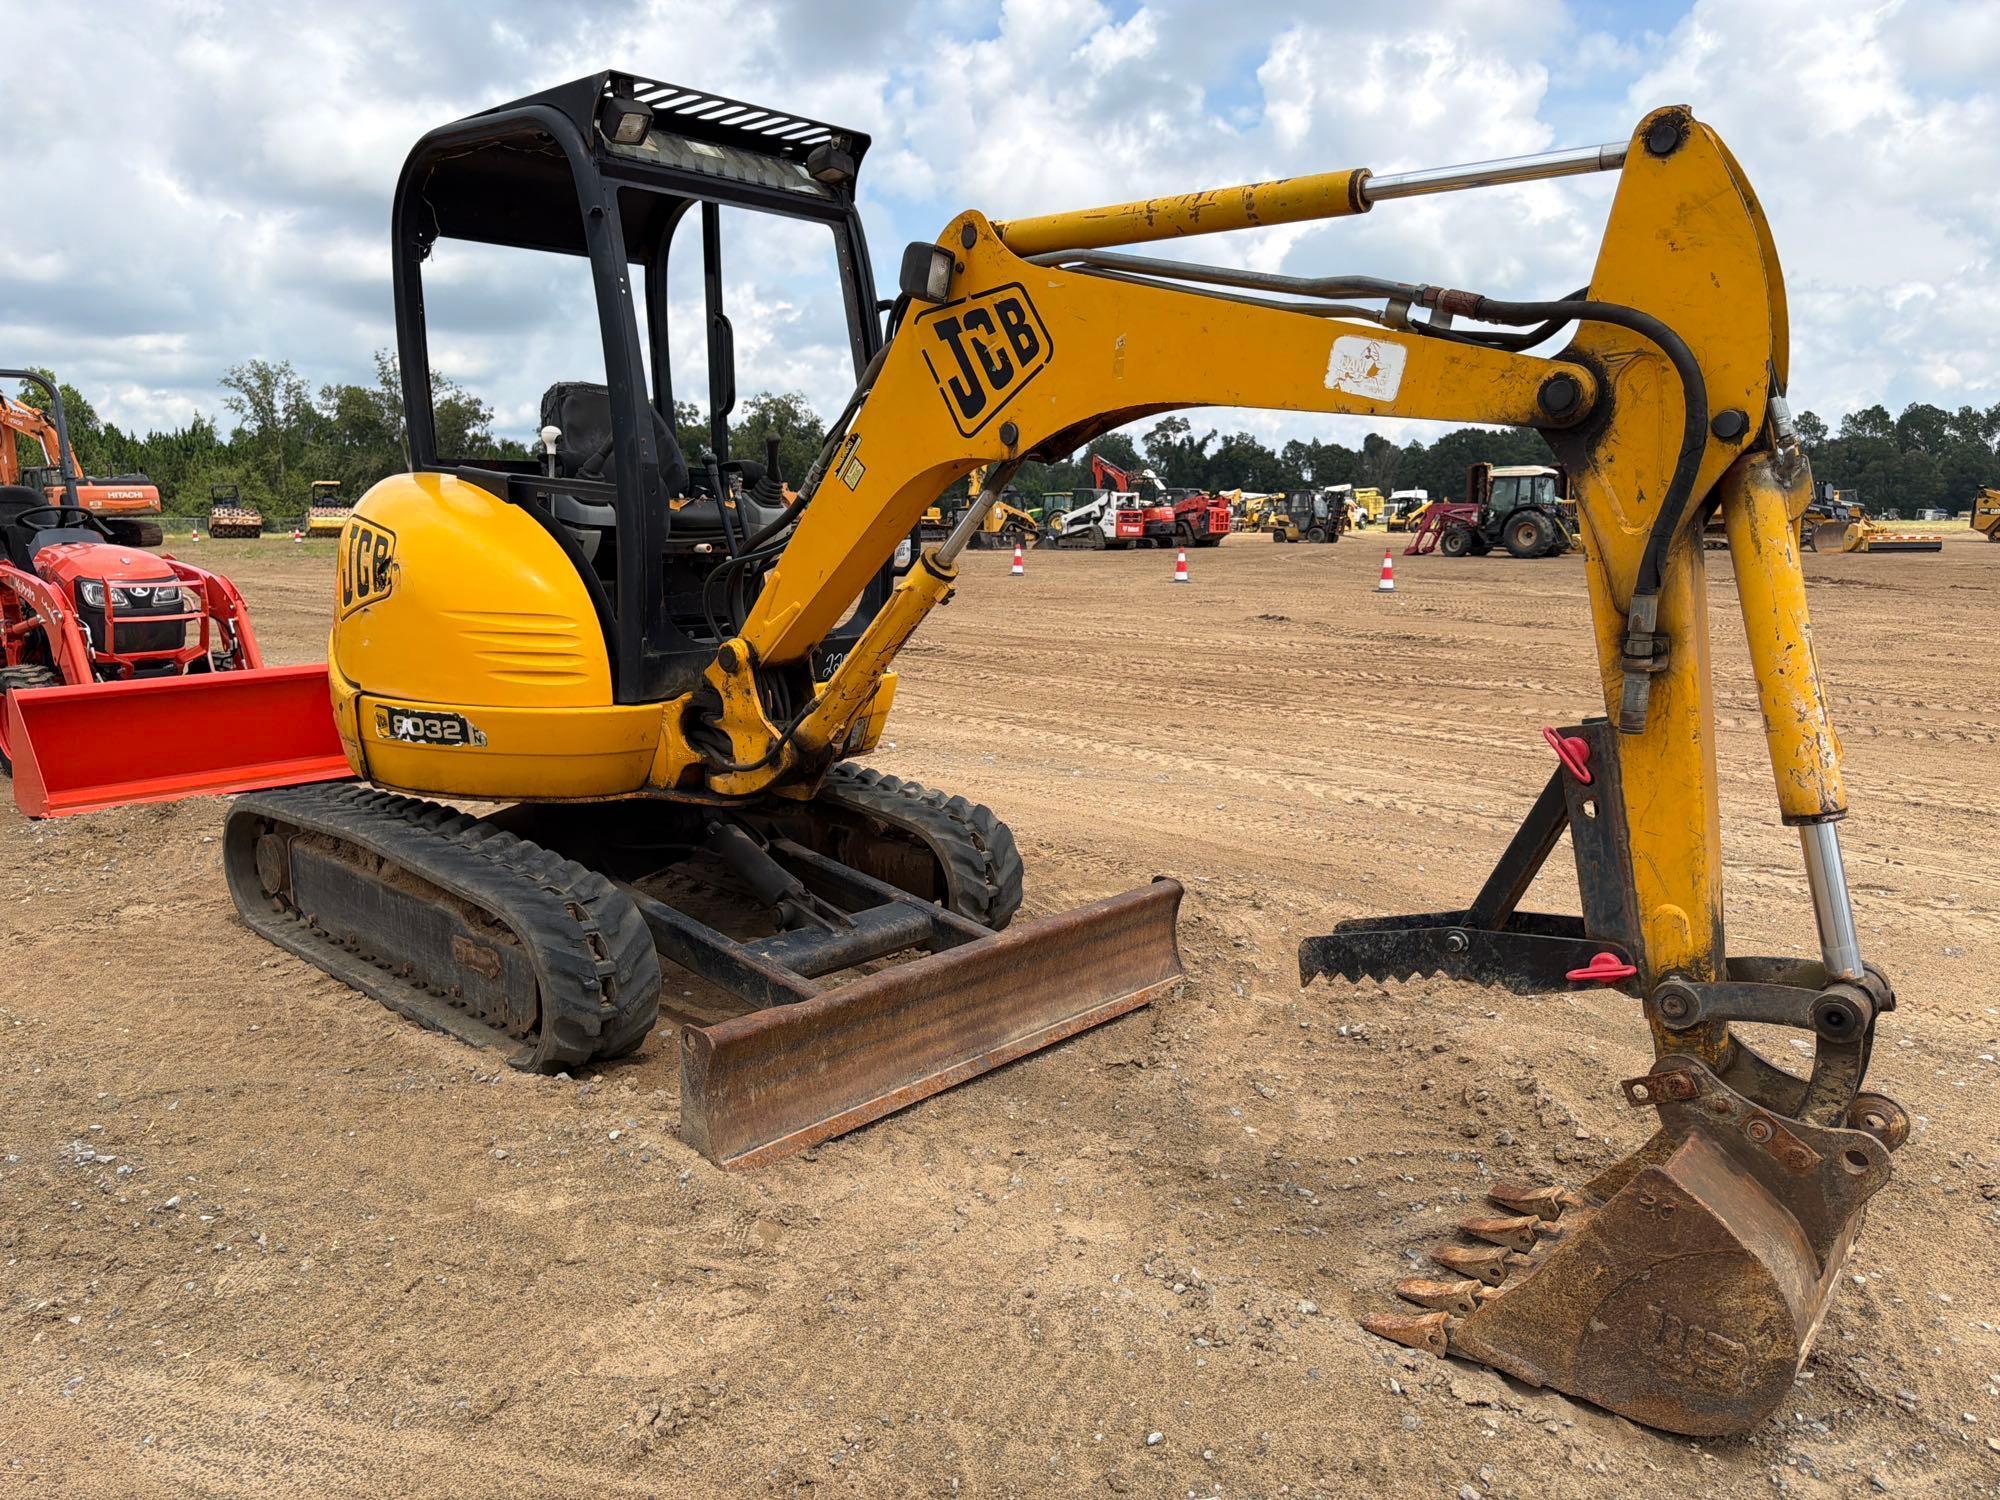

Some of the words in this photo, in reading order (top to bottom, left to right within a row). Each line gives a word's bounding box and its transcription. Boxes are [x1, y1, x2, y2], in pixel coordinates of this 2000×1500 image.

[932, 297, 1040, 420] JCB
[107, 491, 144, 499] HITACHI
[342, 524, 392, 608] JCB
[822, 652, 849, 678] 22
[393, 714, 462, 740] 8032
